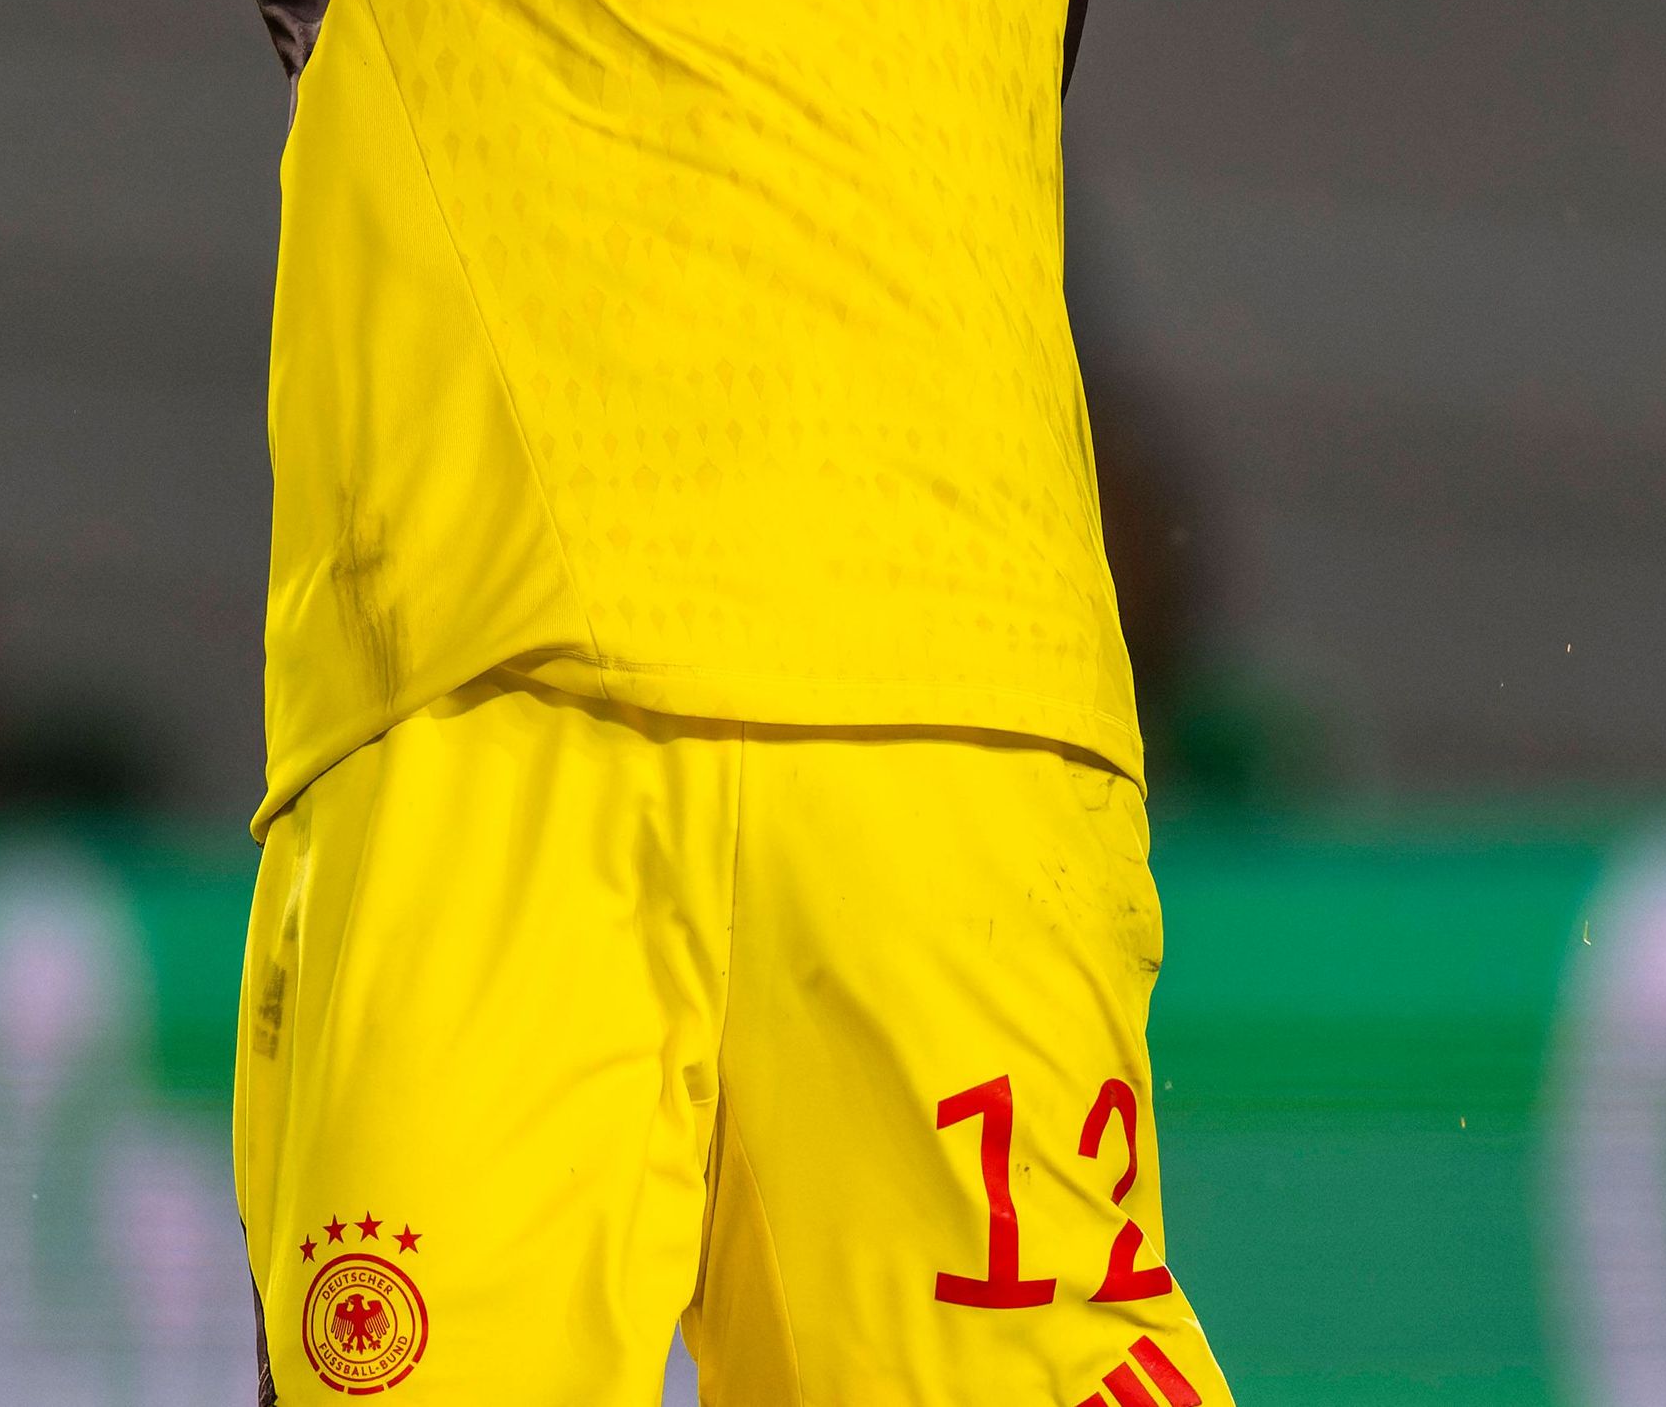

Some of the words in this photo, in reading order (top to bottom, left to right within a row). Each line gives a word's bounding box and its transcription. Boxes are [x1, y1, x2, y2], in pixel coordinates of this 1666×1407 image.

[934, 1074, 1173, 1309] 12
[322, 1272, 393, 1301] DEUTSCHER
[318, 1335, 408, 1377] FUSSBALL-BUND
